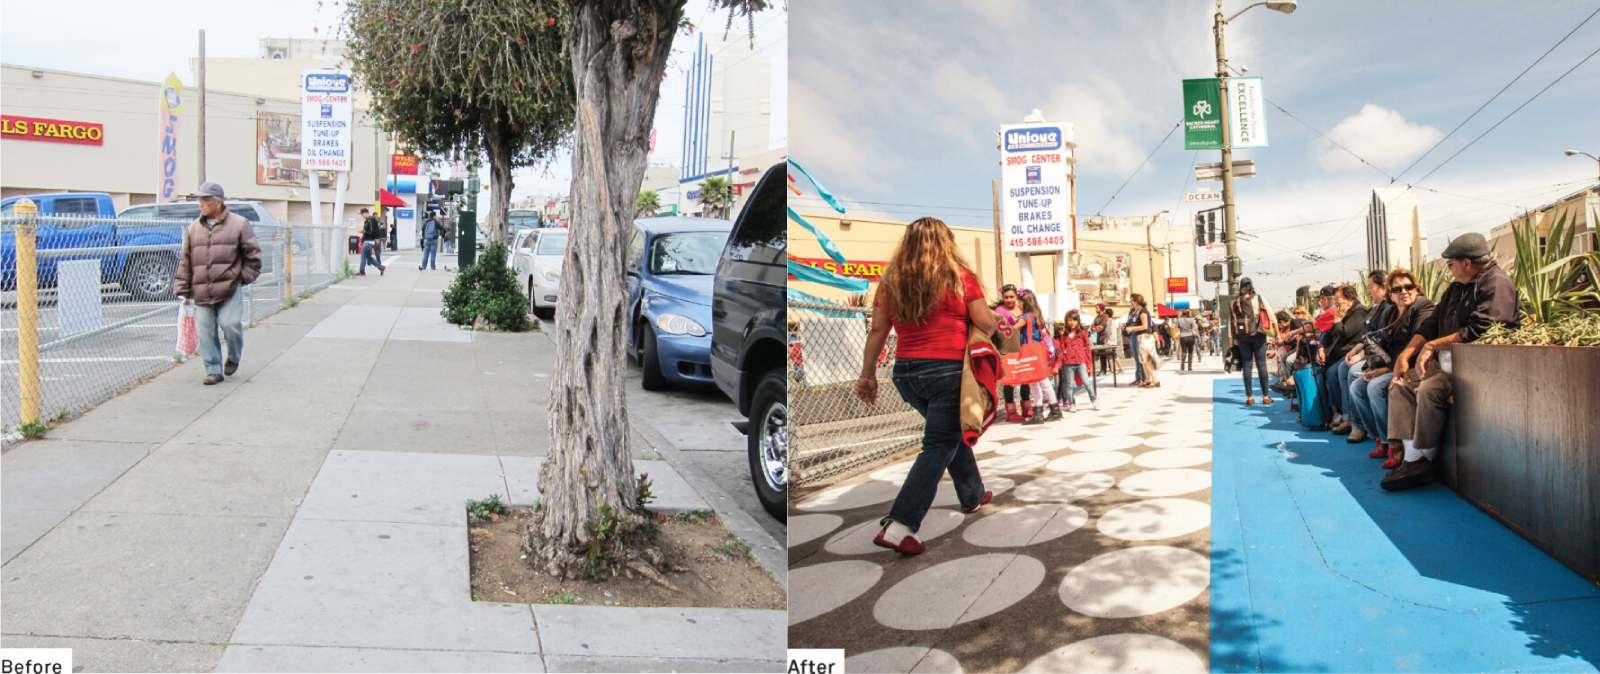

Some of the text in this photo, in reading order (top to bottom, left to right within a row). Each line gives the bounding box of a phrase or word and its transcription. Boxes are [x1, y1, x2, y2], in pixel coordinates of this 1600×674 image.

[1237, 82, 1250, 143] EXCELLENCE
[307, 120, 346, 128] SUSPENSION
[33, 122, 102, 140] FARGO
[313, 139, 339, 147] BRAKES
[307, 148, 345, 157] OIL CHANGE
[1006, 153, 1061, 166] SMOG CENTER
[1009, 185, 1060, 198] SUSPENSION
[1188, 193, 1220, 201] OCEAN
[1017, 198, 1053, 209] TUNE-UP
[1018, 211, 1053, 221] BRAKES
[1010, 222, 1061, 235] OIL CHANGE
